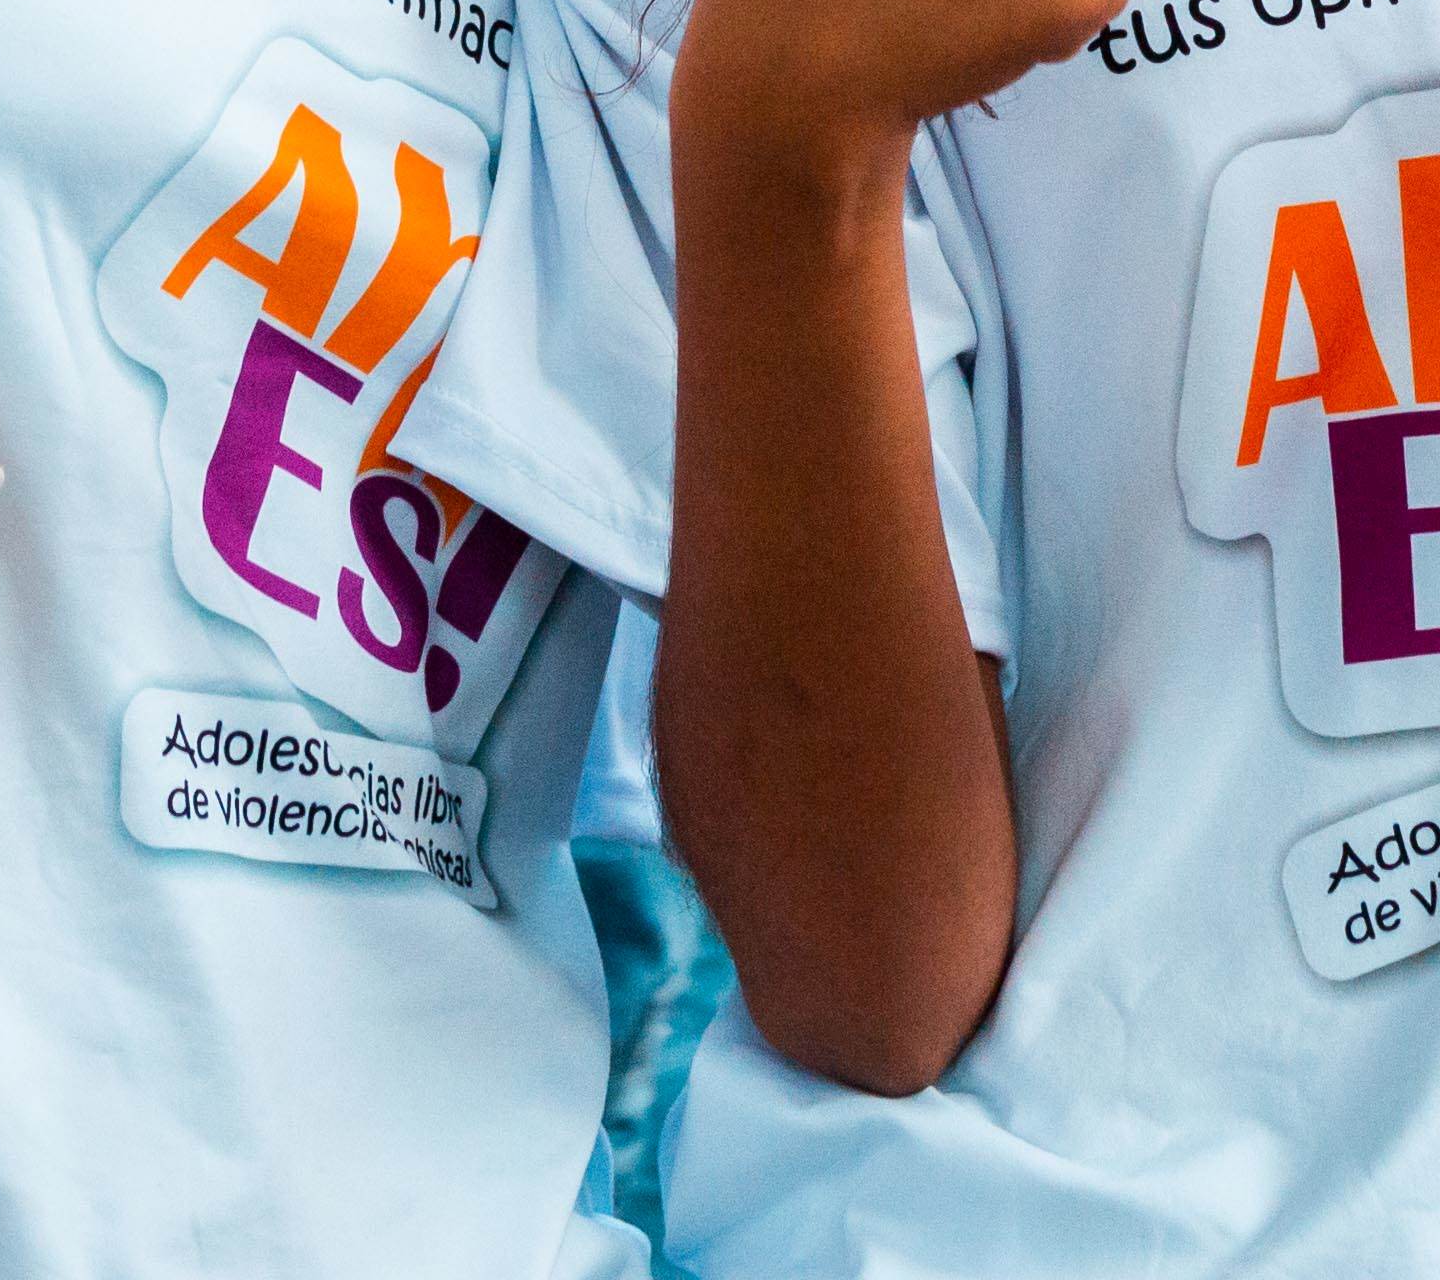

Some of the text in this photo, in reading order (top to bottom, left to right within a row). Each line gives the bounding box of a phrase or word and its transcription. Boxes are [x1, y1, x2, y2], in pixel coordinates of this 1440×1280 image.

[161, 102, 476, 546] Ah
[167, 779, 209, 821] de
[1344, 895, 1402, 946] de
